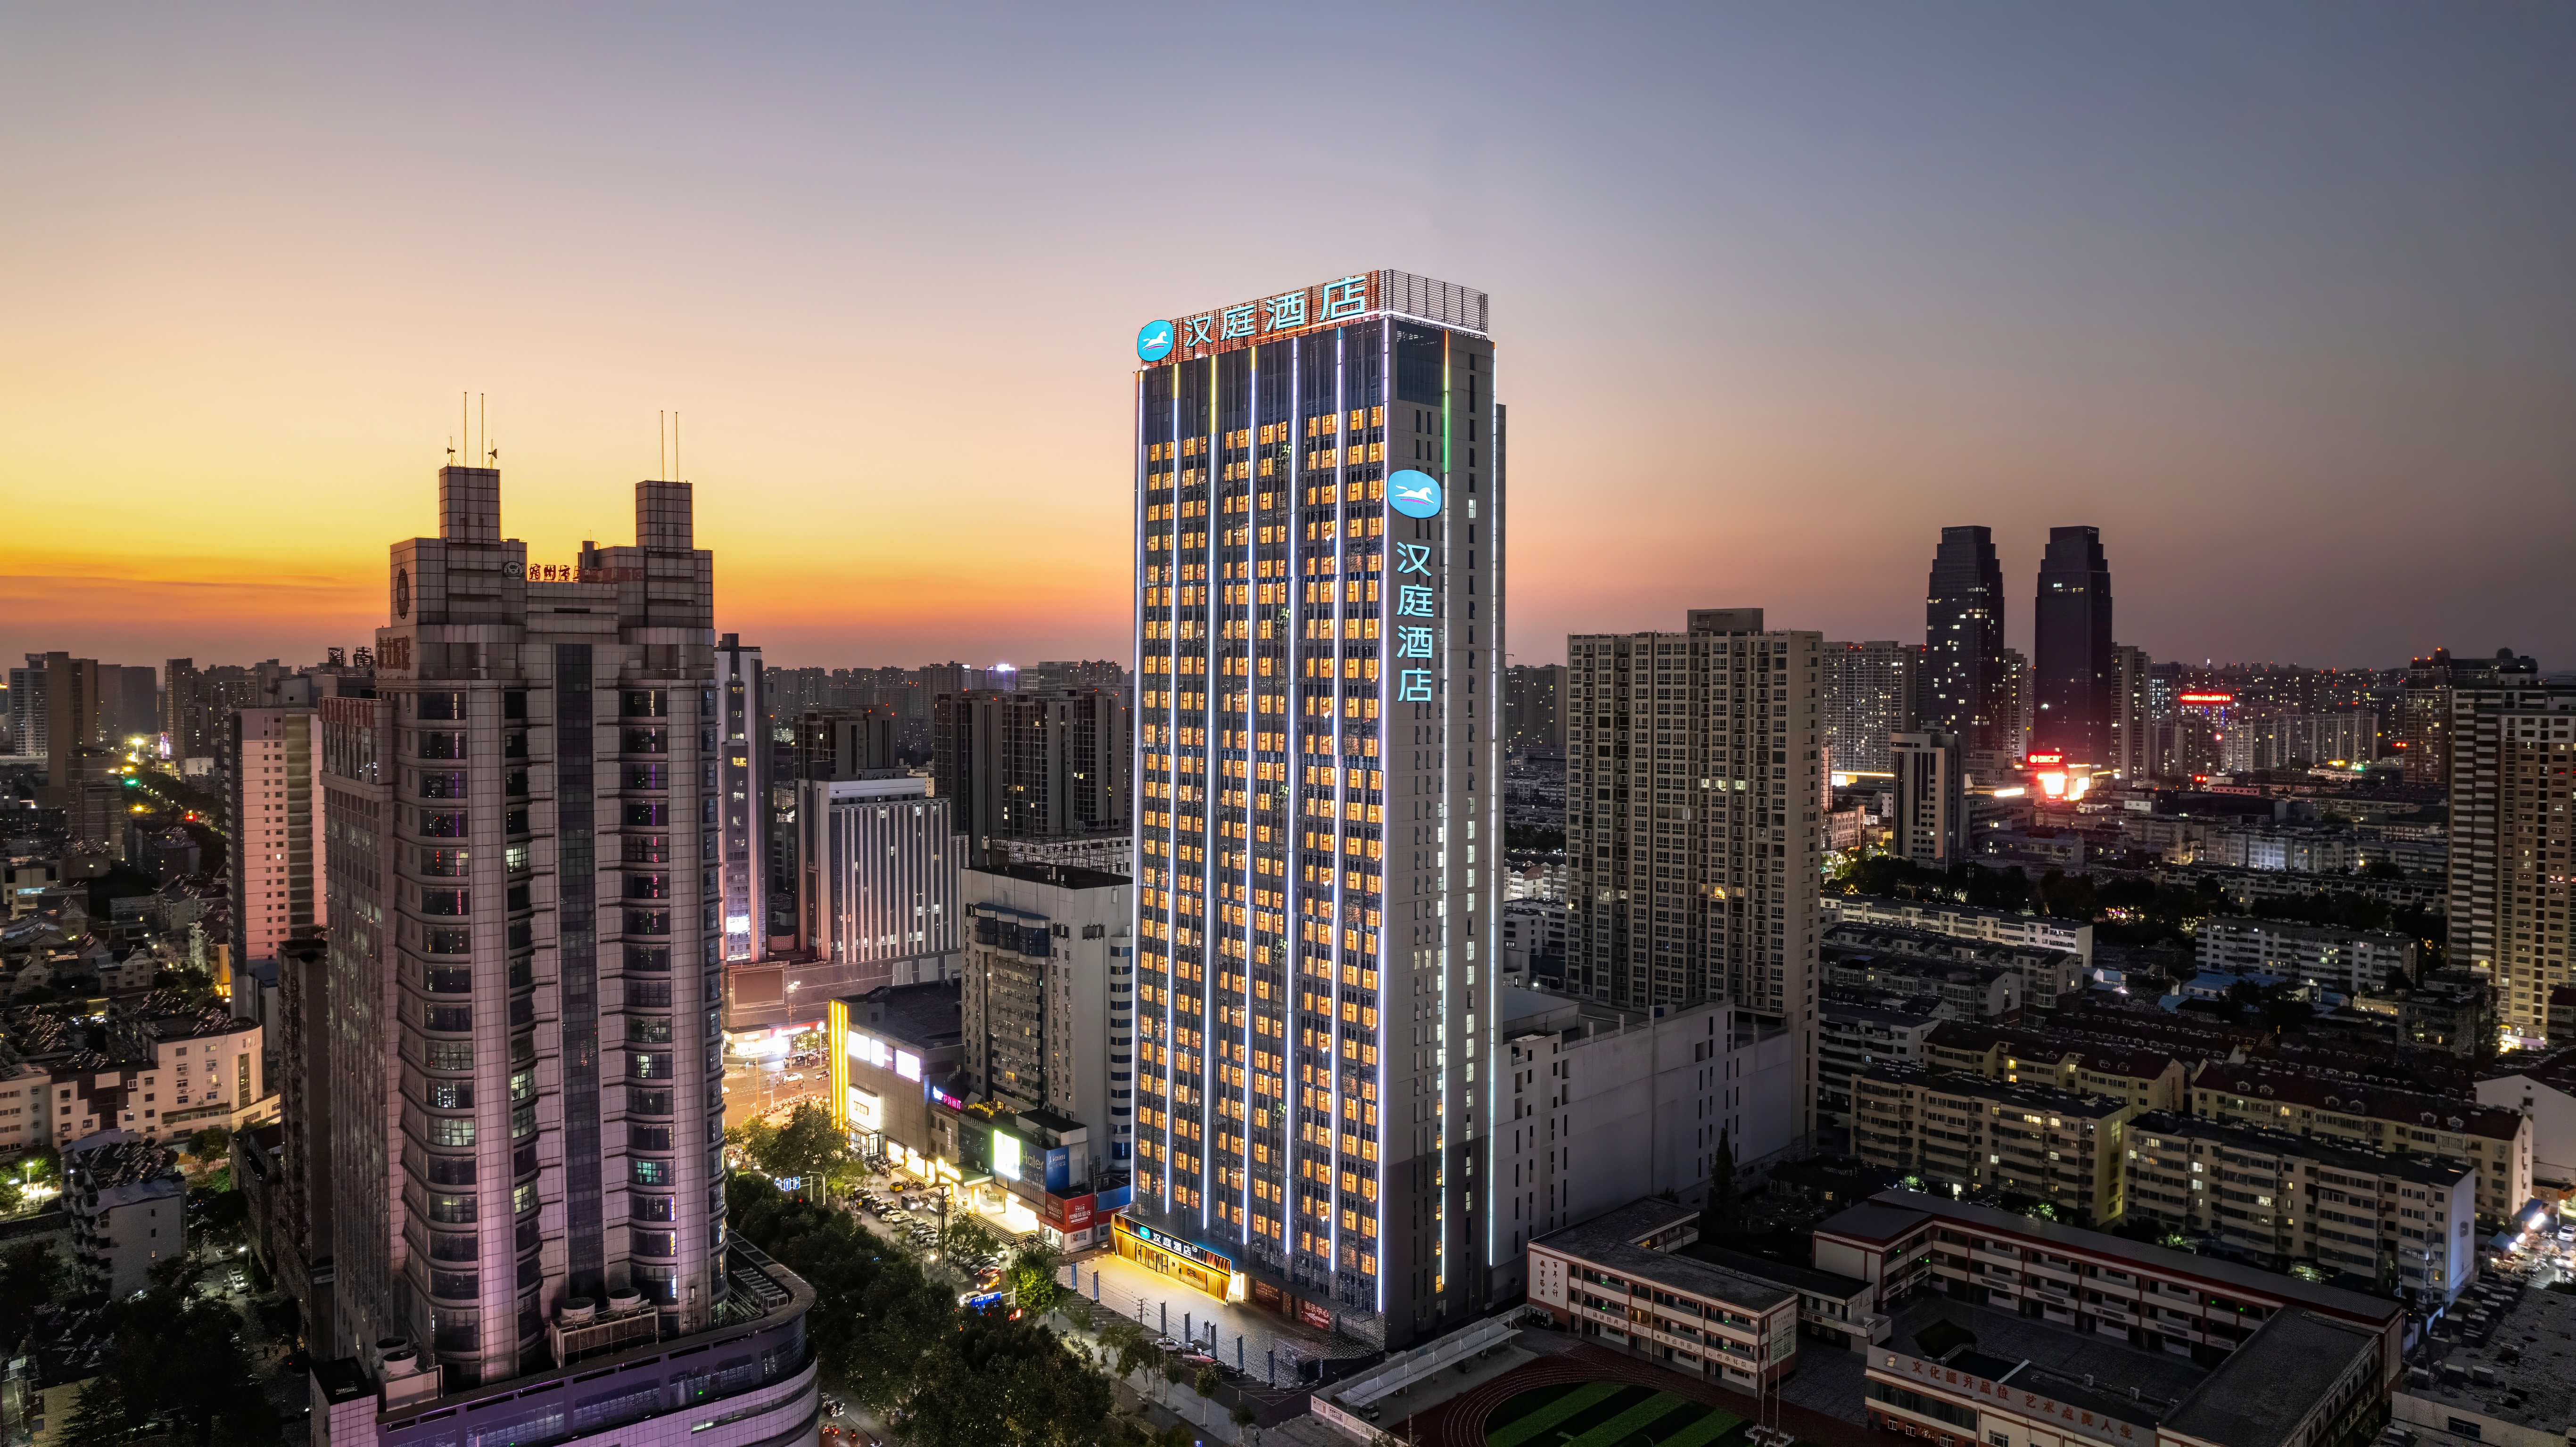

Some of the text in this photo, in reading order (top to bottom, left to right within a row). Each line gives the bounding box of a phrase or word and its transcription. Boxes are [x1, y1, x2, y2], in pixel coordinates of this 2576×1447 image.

[1185, 275, 1365, 347] 汉庭酒店
[1396, 542, 1434, 702] 汉庭酒店
